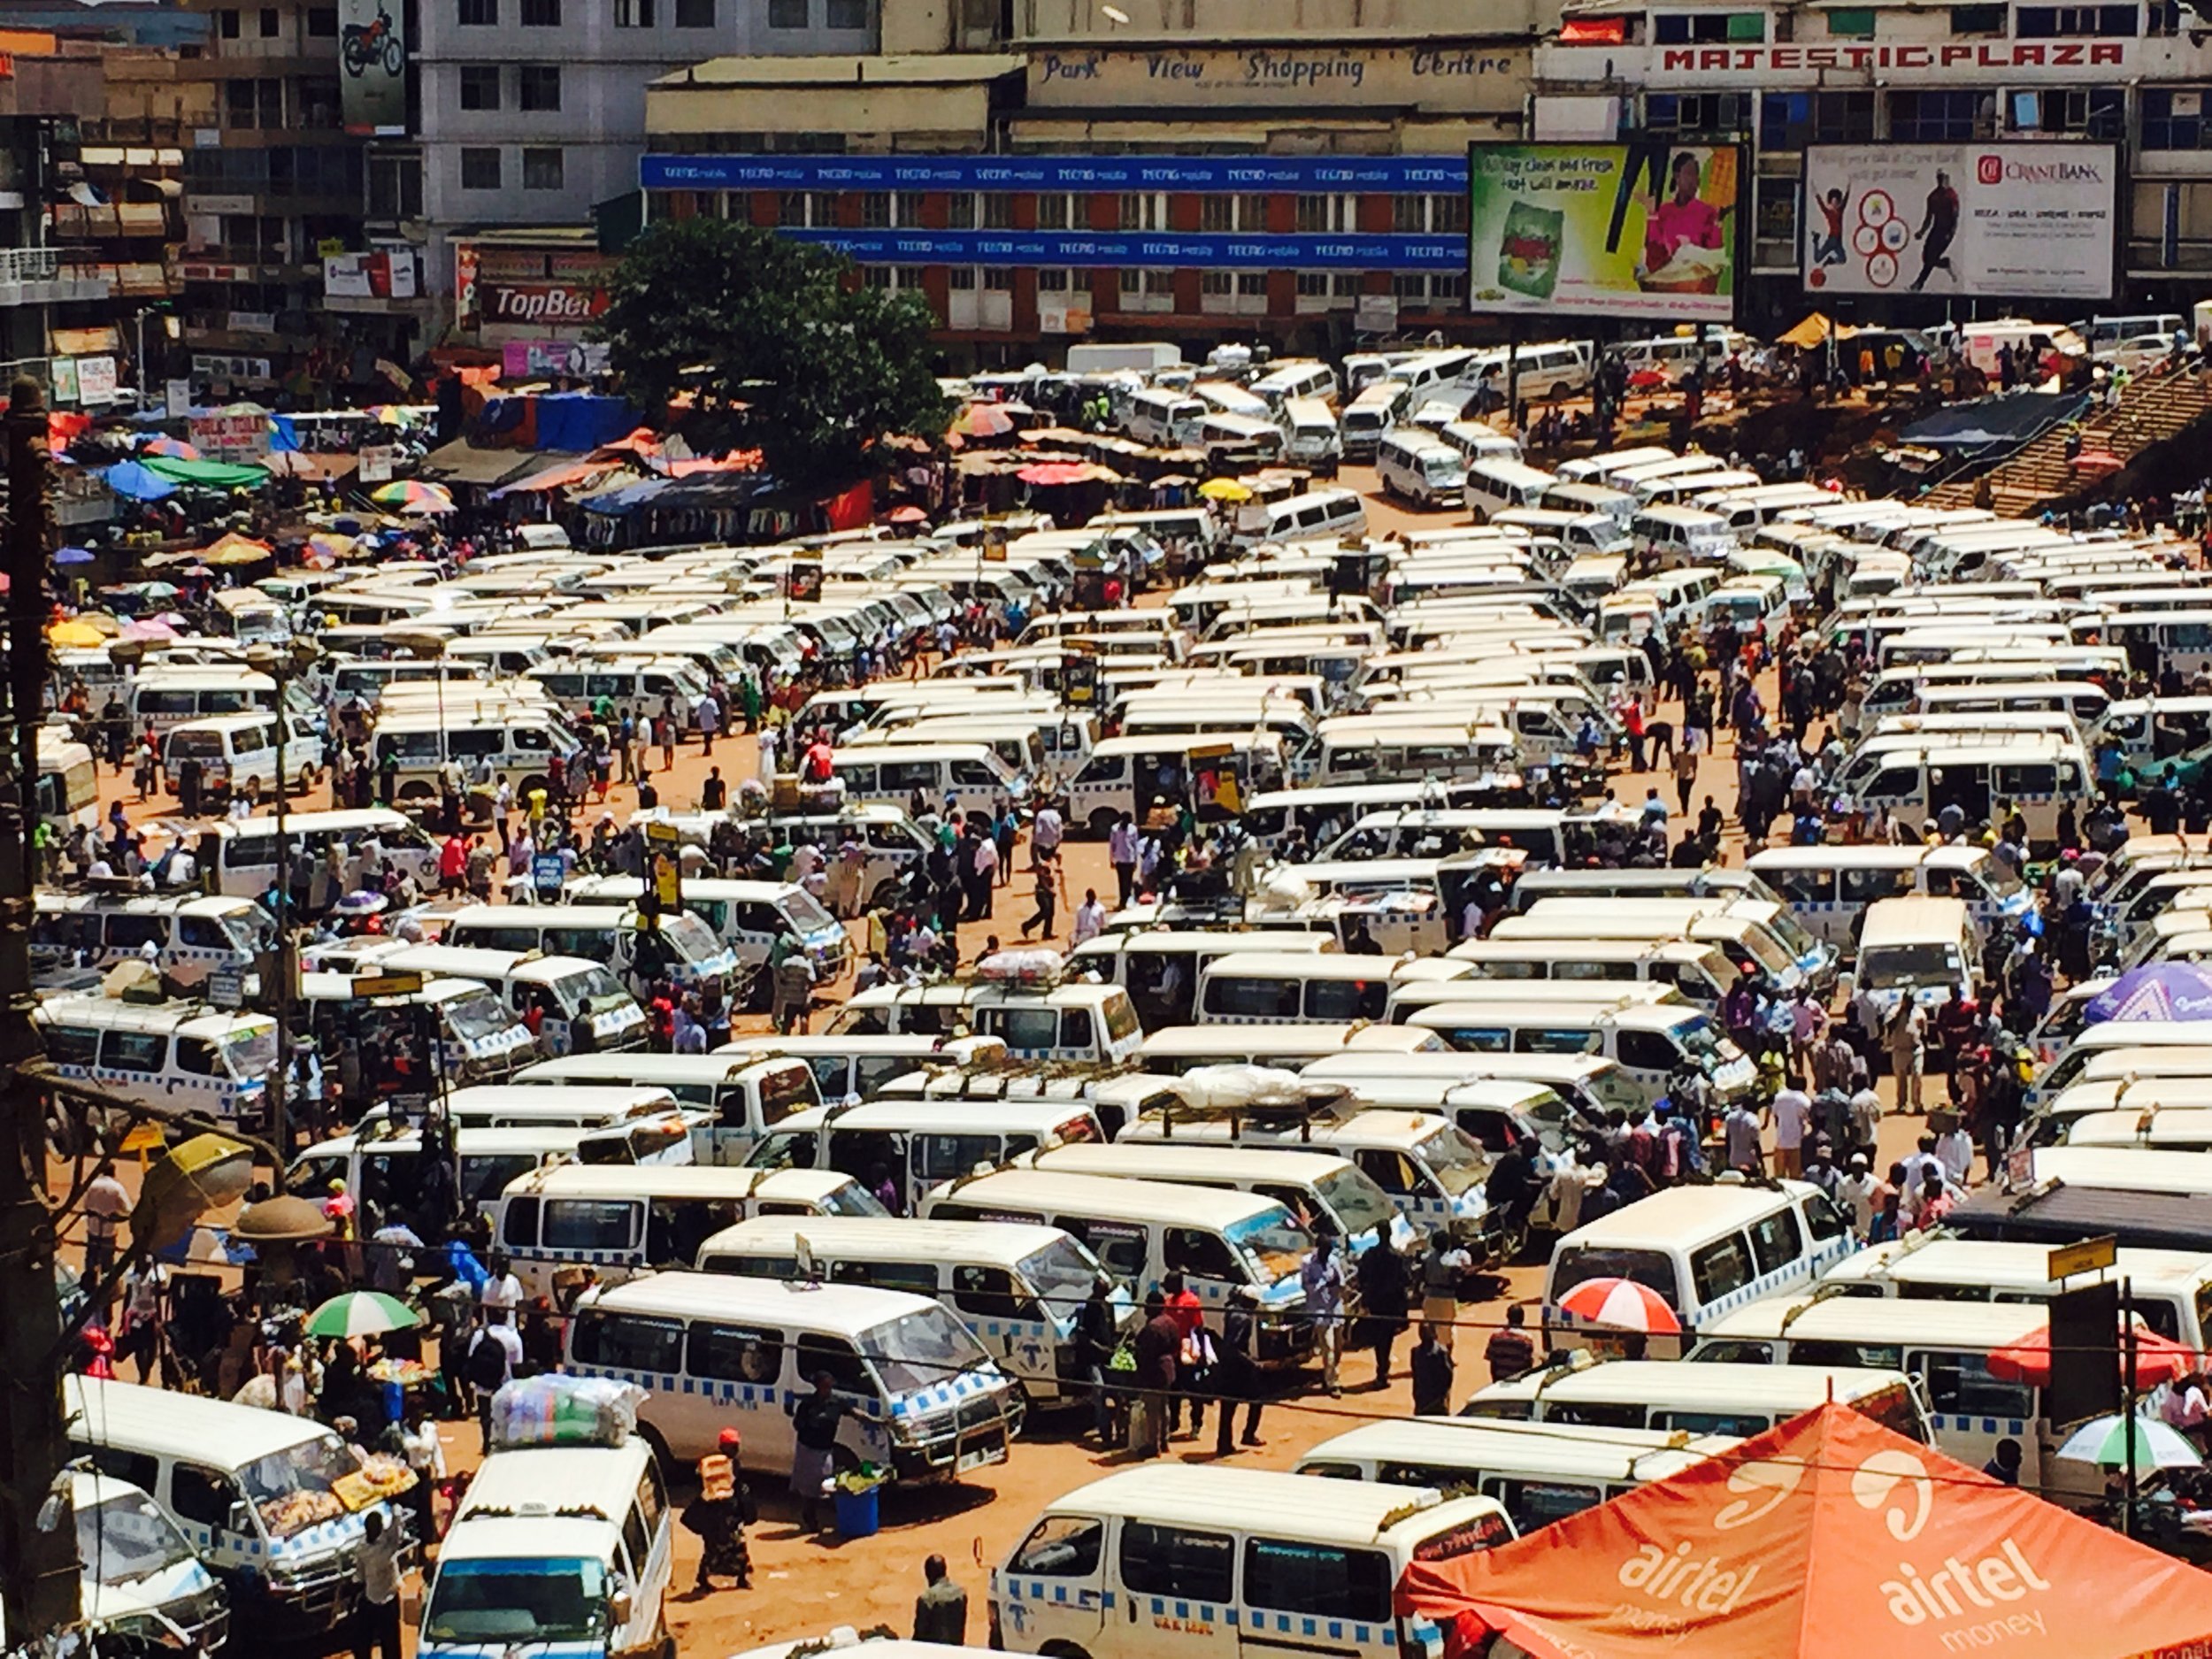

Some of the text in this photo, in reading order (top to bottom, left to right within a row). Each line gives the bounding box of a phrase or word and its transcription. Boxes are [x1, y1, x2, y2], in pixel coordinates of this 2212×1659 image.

[1041, 50, 1512, 87] Park View Shopping Centre
[1663, 43, 2124, 71] MAJESTIC PLAZA
[1618, 1540, 1761, 1614] airtel
[1878, 1537, 2052, 1626] airtel
[1939, 1609, 2047, 1655] money
